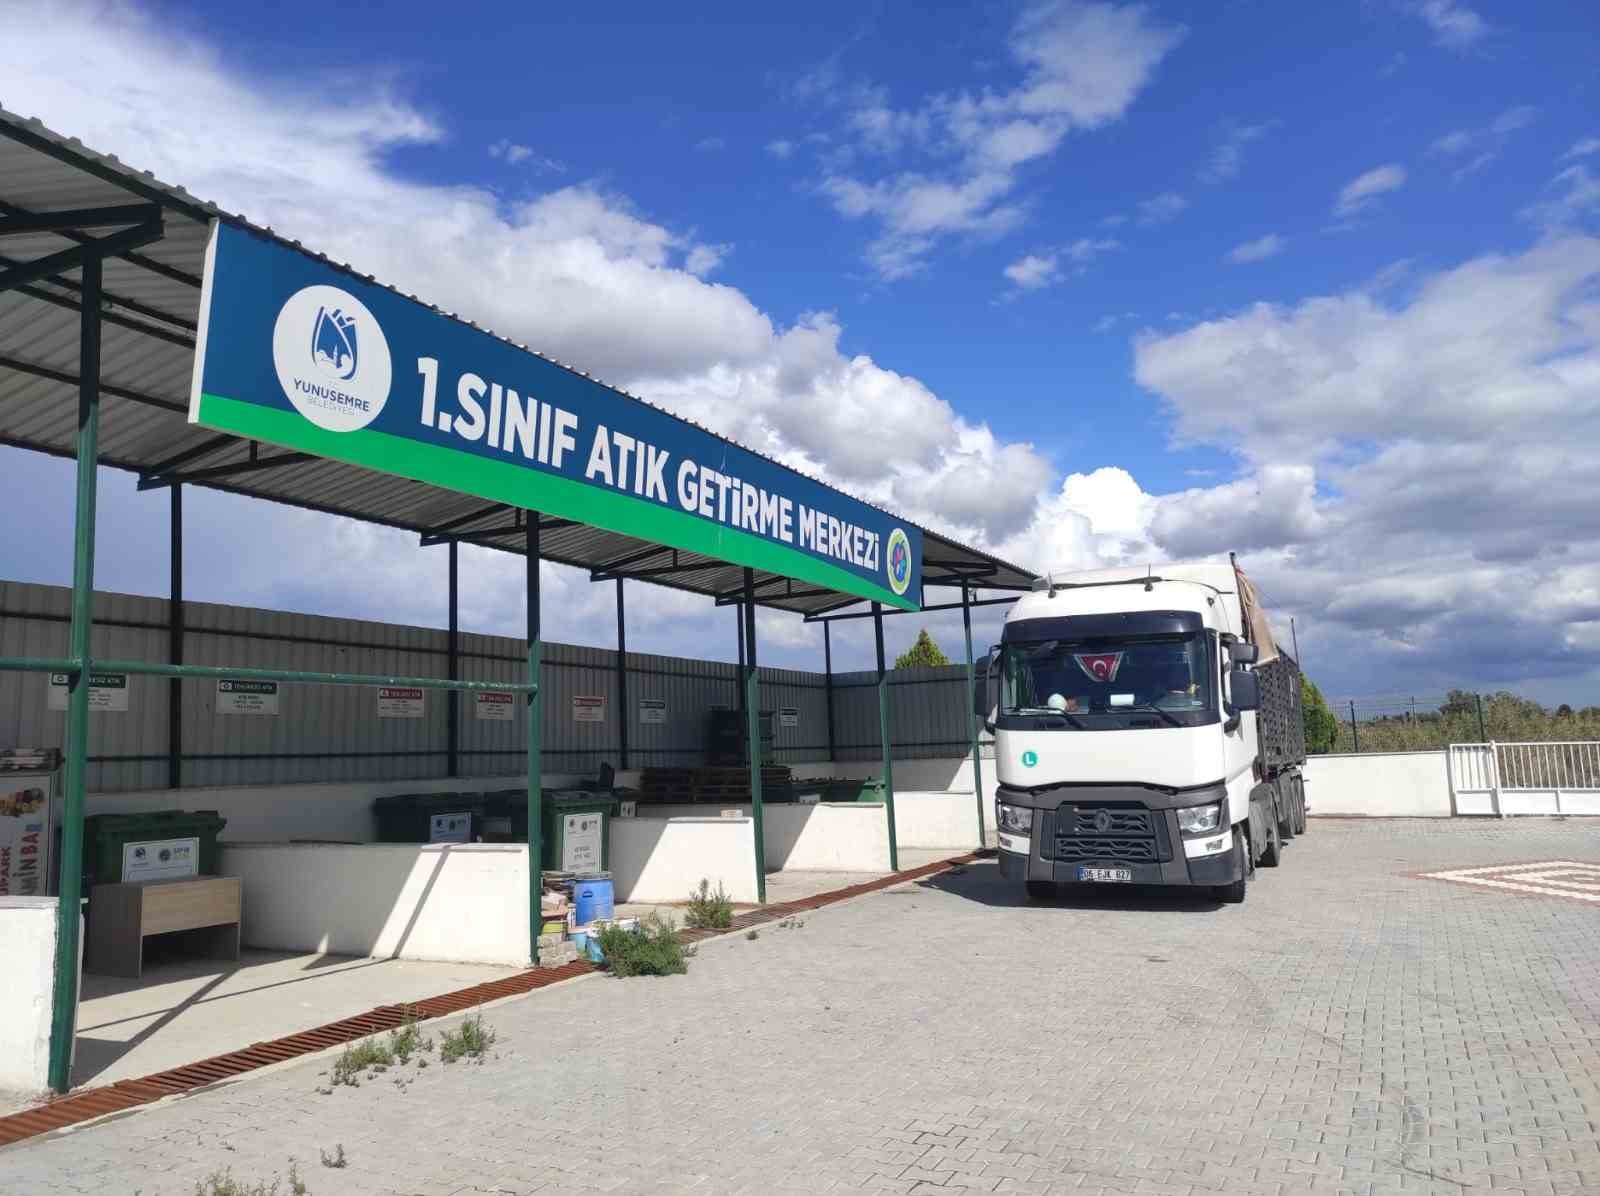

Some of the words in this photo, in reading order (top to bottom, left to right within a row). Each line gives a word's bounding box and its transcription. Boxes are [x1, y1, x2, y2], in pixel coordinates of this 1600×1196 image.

[293, 377, 371, 412] YUNUSEMRE
[417, 356, 578, 468] 1.SINIF
[585, 423, 670, 504] ATIK
